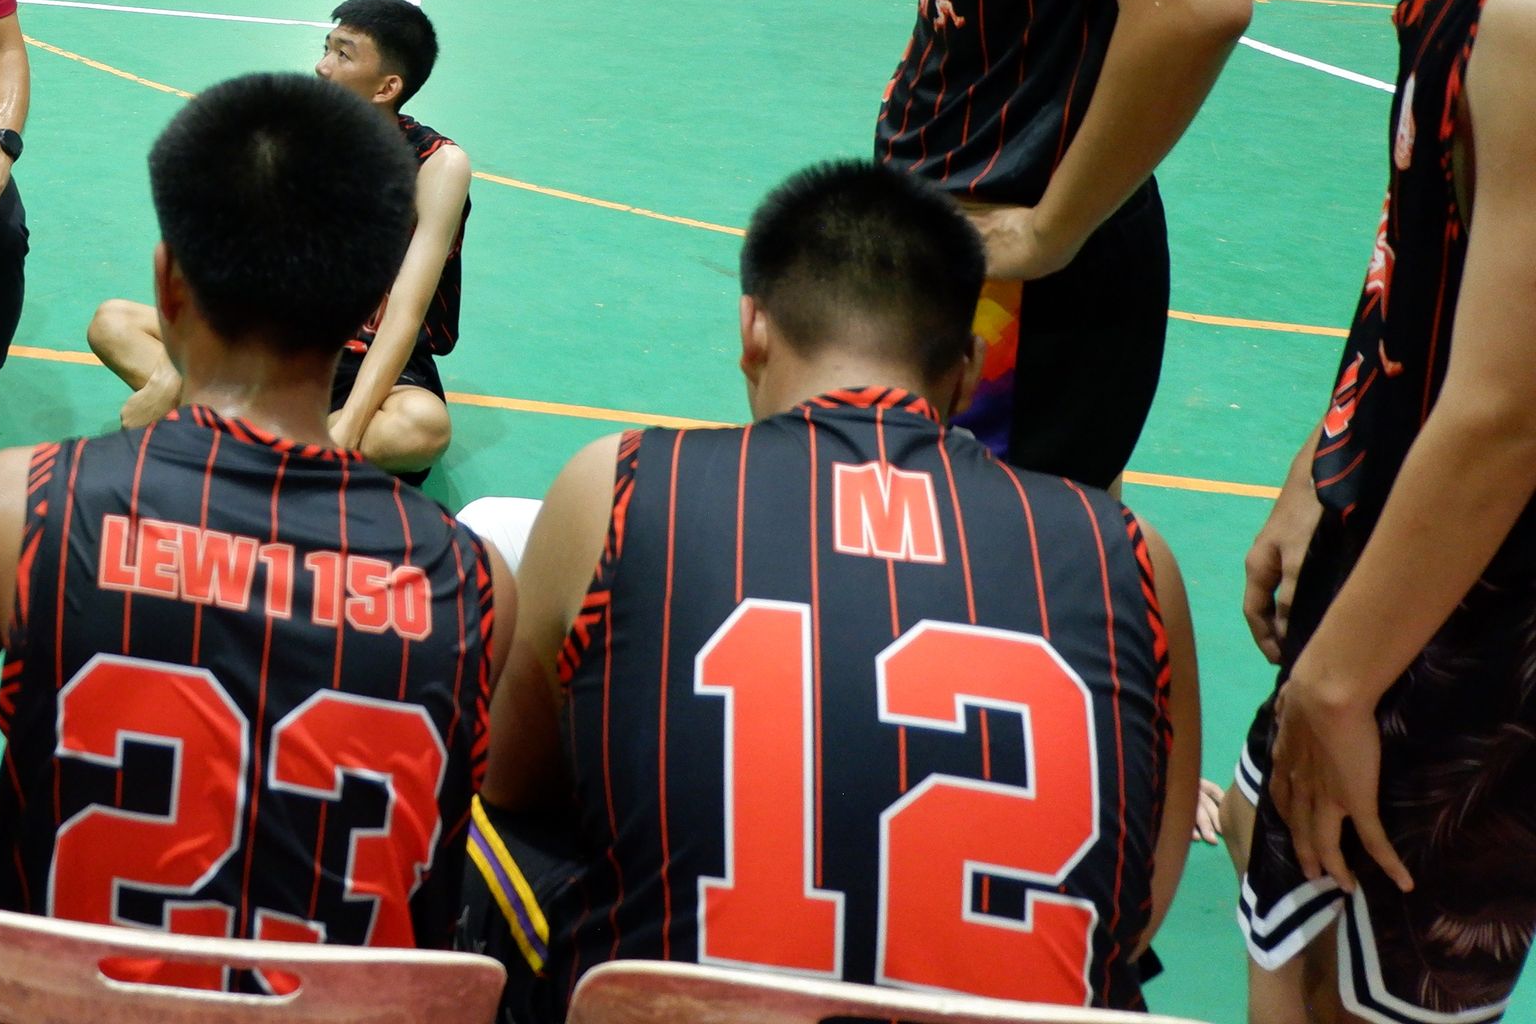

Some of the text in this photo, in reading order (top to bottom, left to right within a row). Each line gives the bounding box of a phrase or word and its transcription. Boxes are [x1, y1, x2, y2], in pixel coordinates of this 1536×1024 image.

[832, 461, 946, 564] M
[47, 652, 449, 995] 23
[694, 597, 1100, 1008] 12
